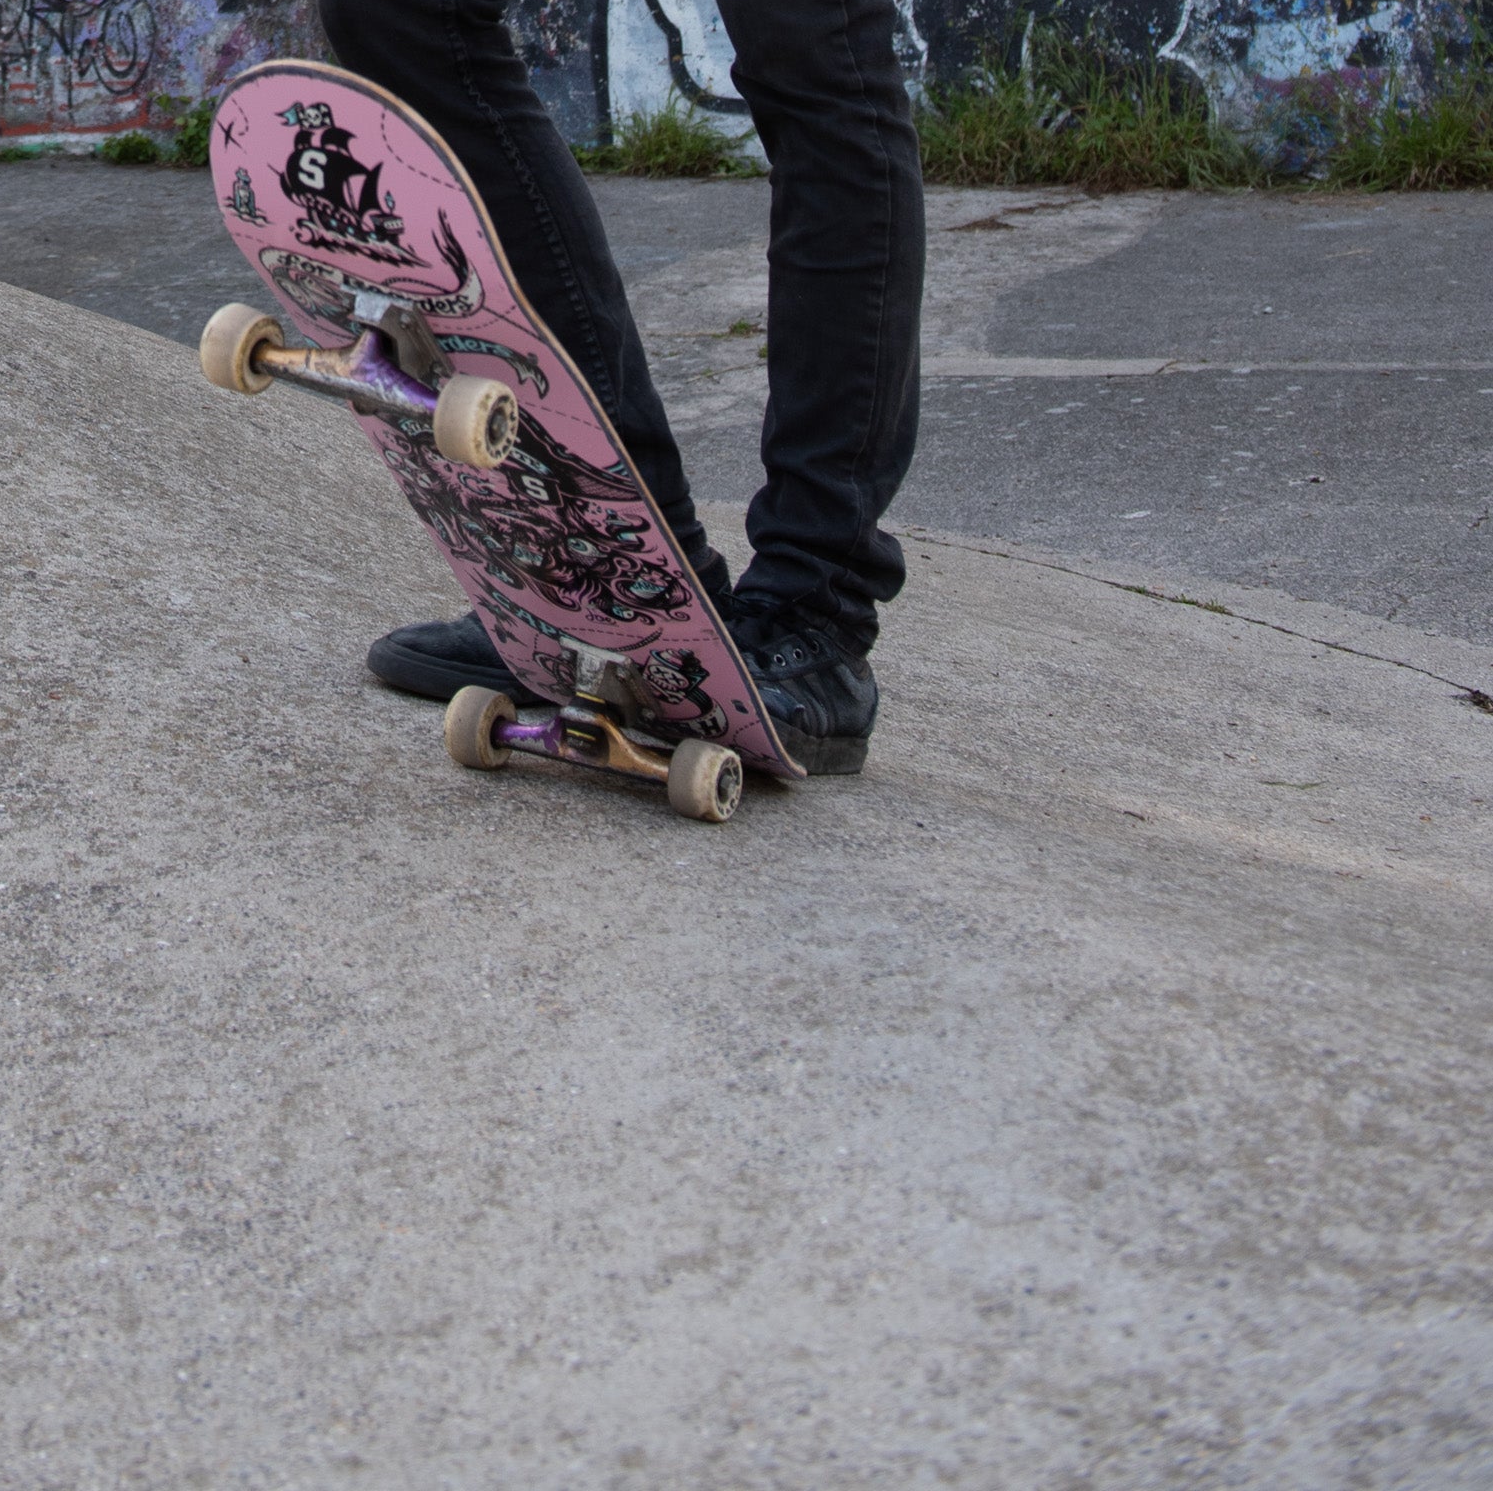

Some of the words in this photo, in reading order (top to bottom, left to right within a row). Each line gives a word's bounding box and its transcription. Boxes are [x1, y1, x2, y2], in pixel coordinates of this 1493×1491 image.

[297, 149, 328, 190] S
[276, 254, 337, 278] for
[521, 474, 550, 501] S
